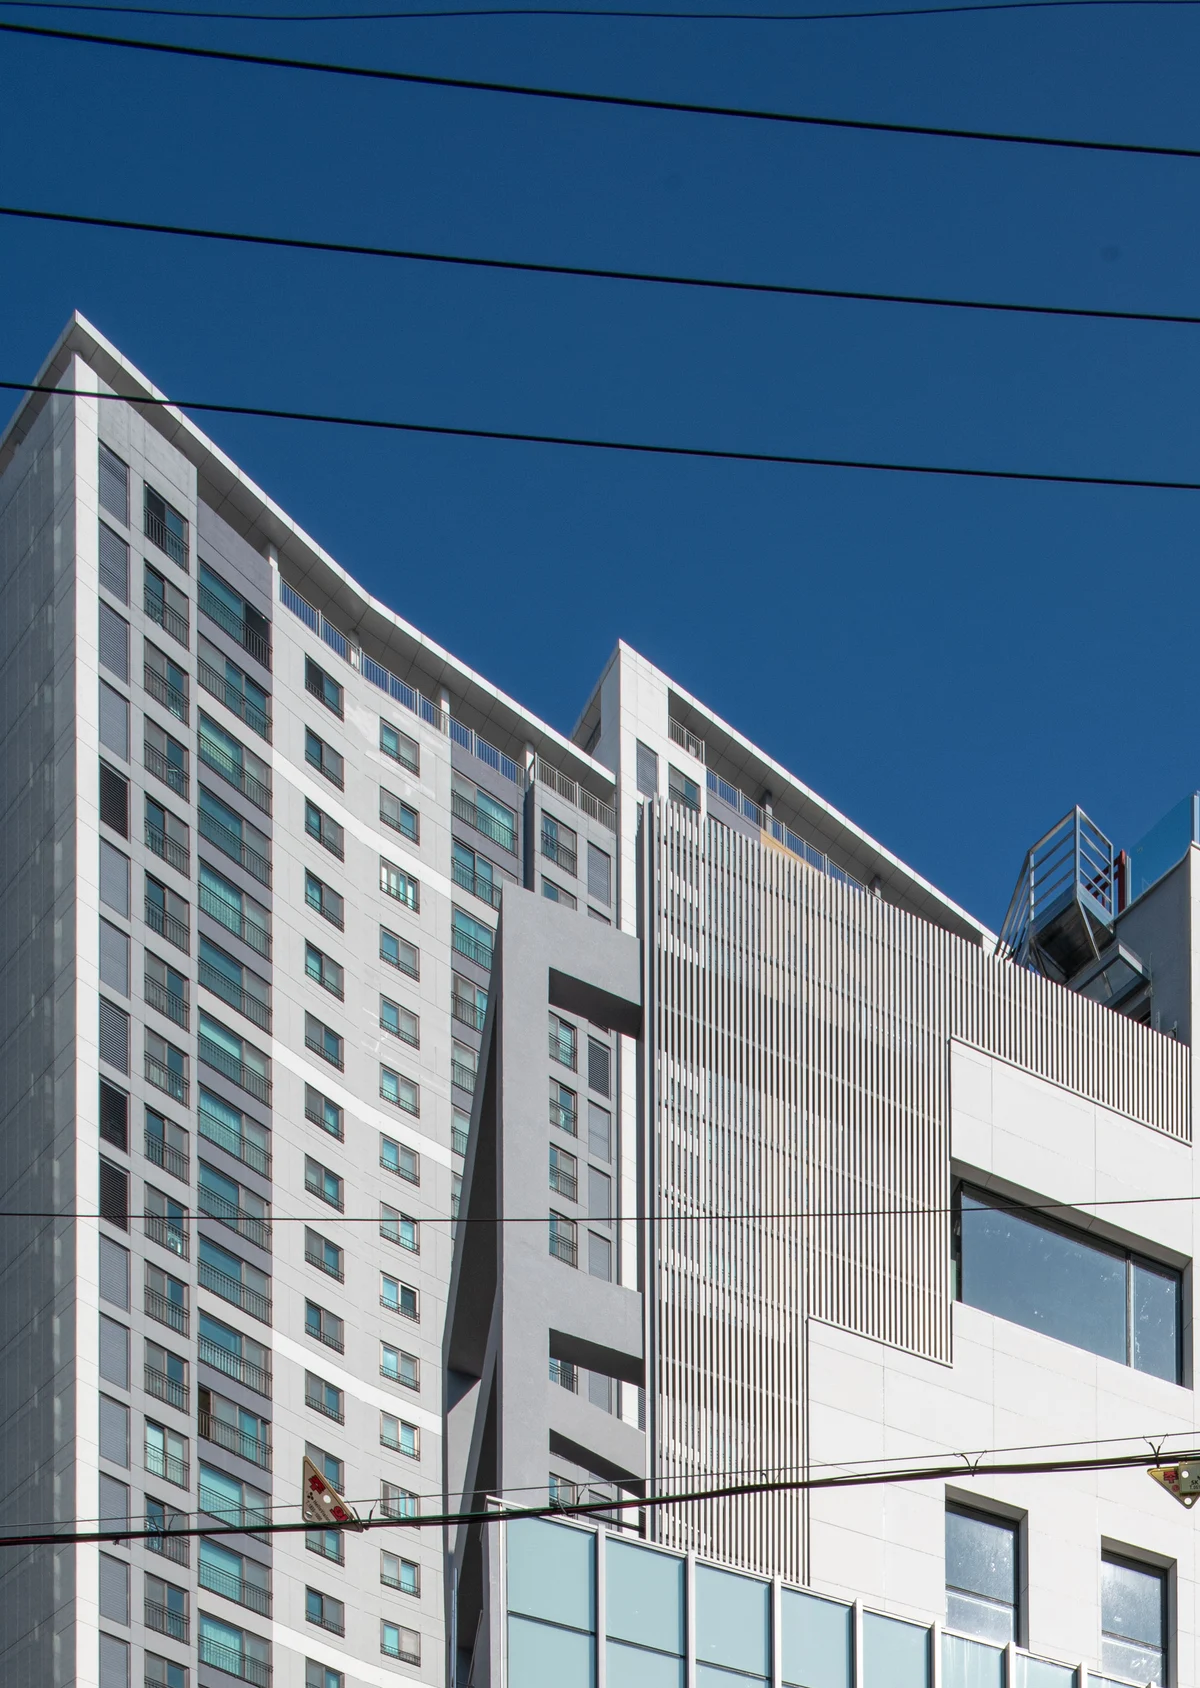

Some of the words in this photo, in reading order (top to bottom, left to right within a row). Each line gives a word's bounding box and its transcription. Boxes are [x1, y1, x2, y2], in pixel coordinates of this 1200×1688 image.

[1163, 1471, 1178, 1484] 주
[308, 1475, 326, 1495] 주
[329, 1505, 349, 1522] 의
